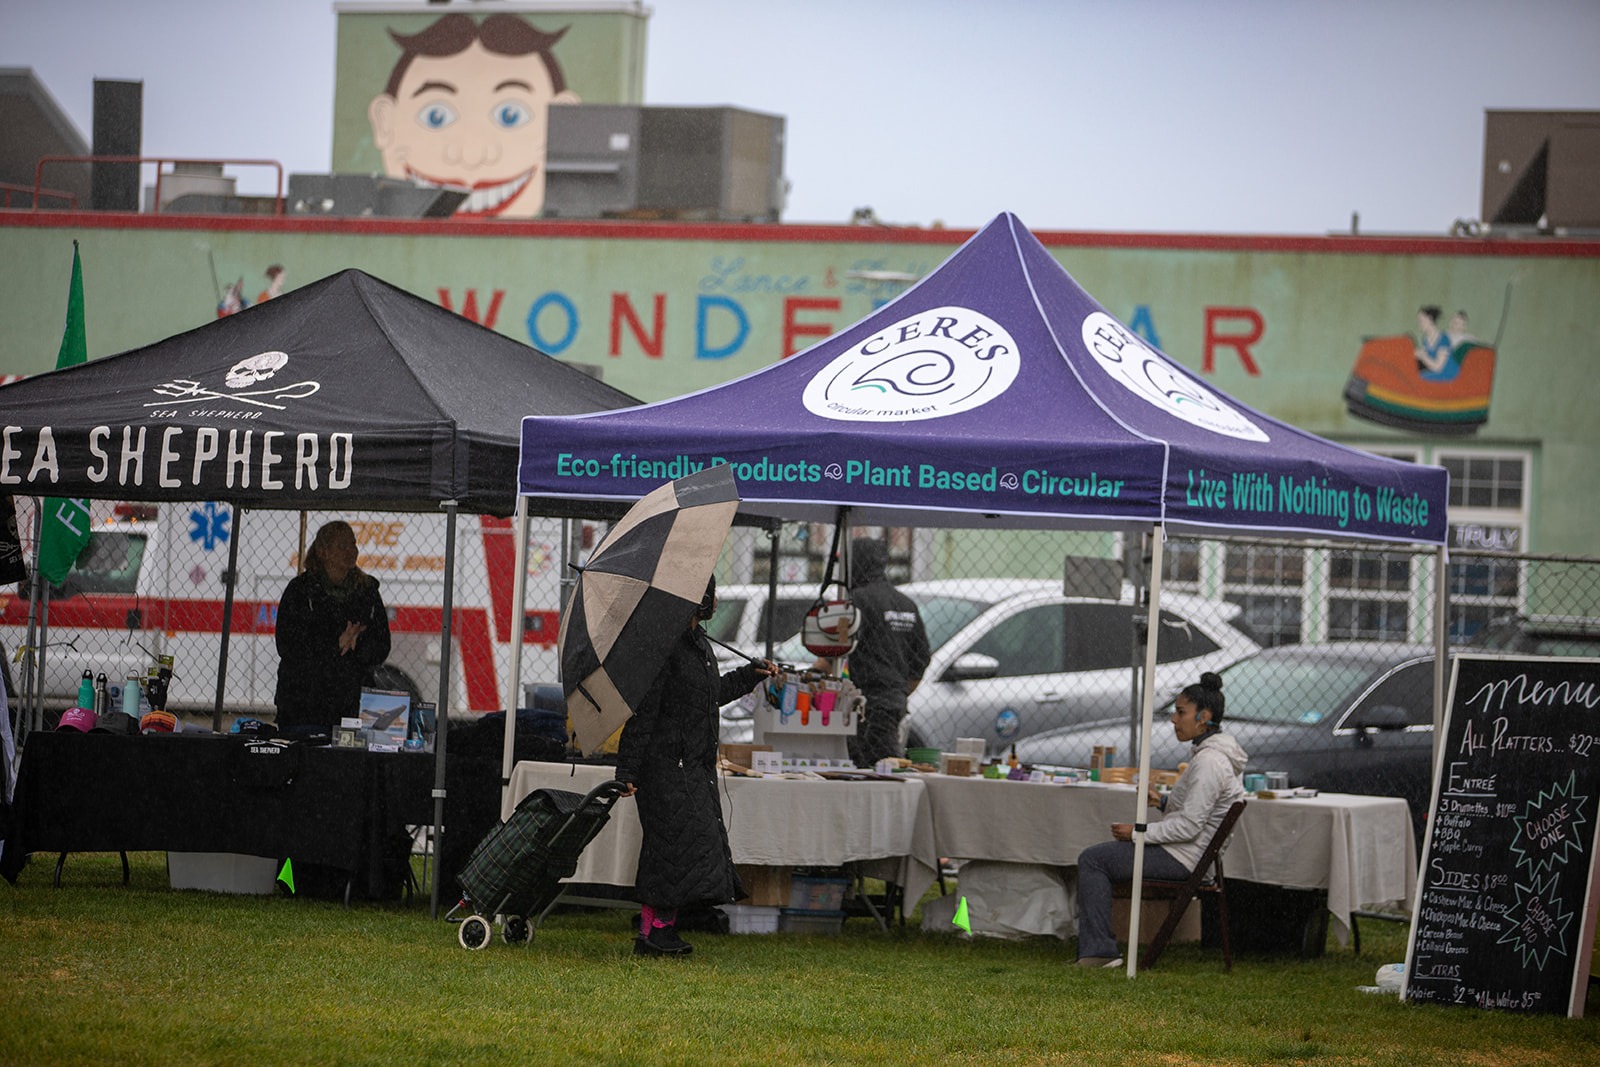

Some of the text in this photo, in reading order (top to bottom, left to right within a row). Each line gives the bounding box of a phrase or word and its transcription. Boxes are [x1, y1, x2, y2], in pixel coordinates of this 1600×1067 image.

[436, 288, 1266, 377] WONDE AR
[860, 316, 1009, 361] CERES
[150, 409, 263, 419] SEA SHEPHERD
[827, 402, 938, 416] circular market
[86, 425, 354, 491] SHEPHERD
[846, 460, 912, 487] Plant
[918, 464, 998, 492] Based
[1022, 469, 1125, 498] Circular
[1186, 469, 1429, 528] Live With Nothing to Waste
[1455, 524, 1519, 550] TRULY
[1440, 799, 1449, 812] 3
[1440, 827, 1461, 840] BBQ
[1443, 815, 1472, 828] Buffalo
[1526, 803, 1571, 840] CHOOSE
[1540, 825, 1566, 849] ONE
[1520, 913, 1538, 944] TWO
[1526, 896, 1557, 938] CHOOSE
